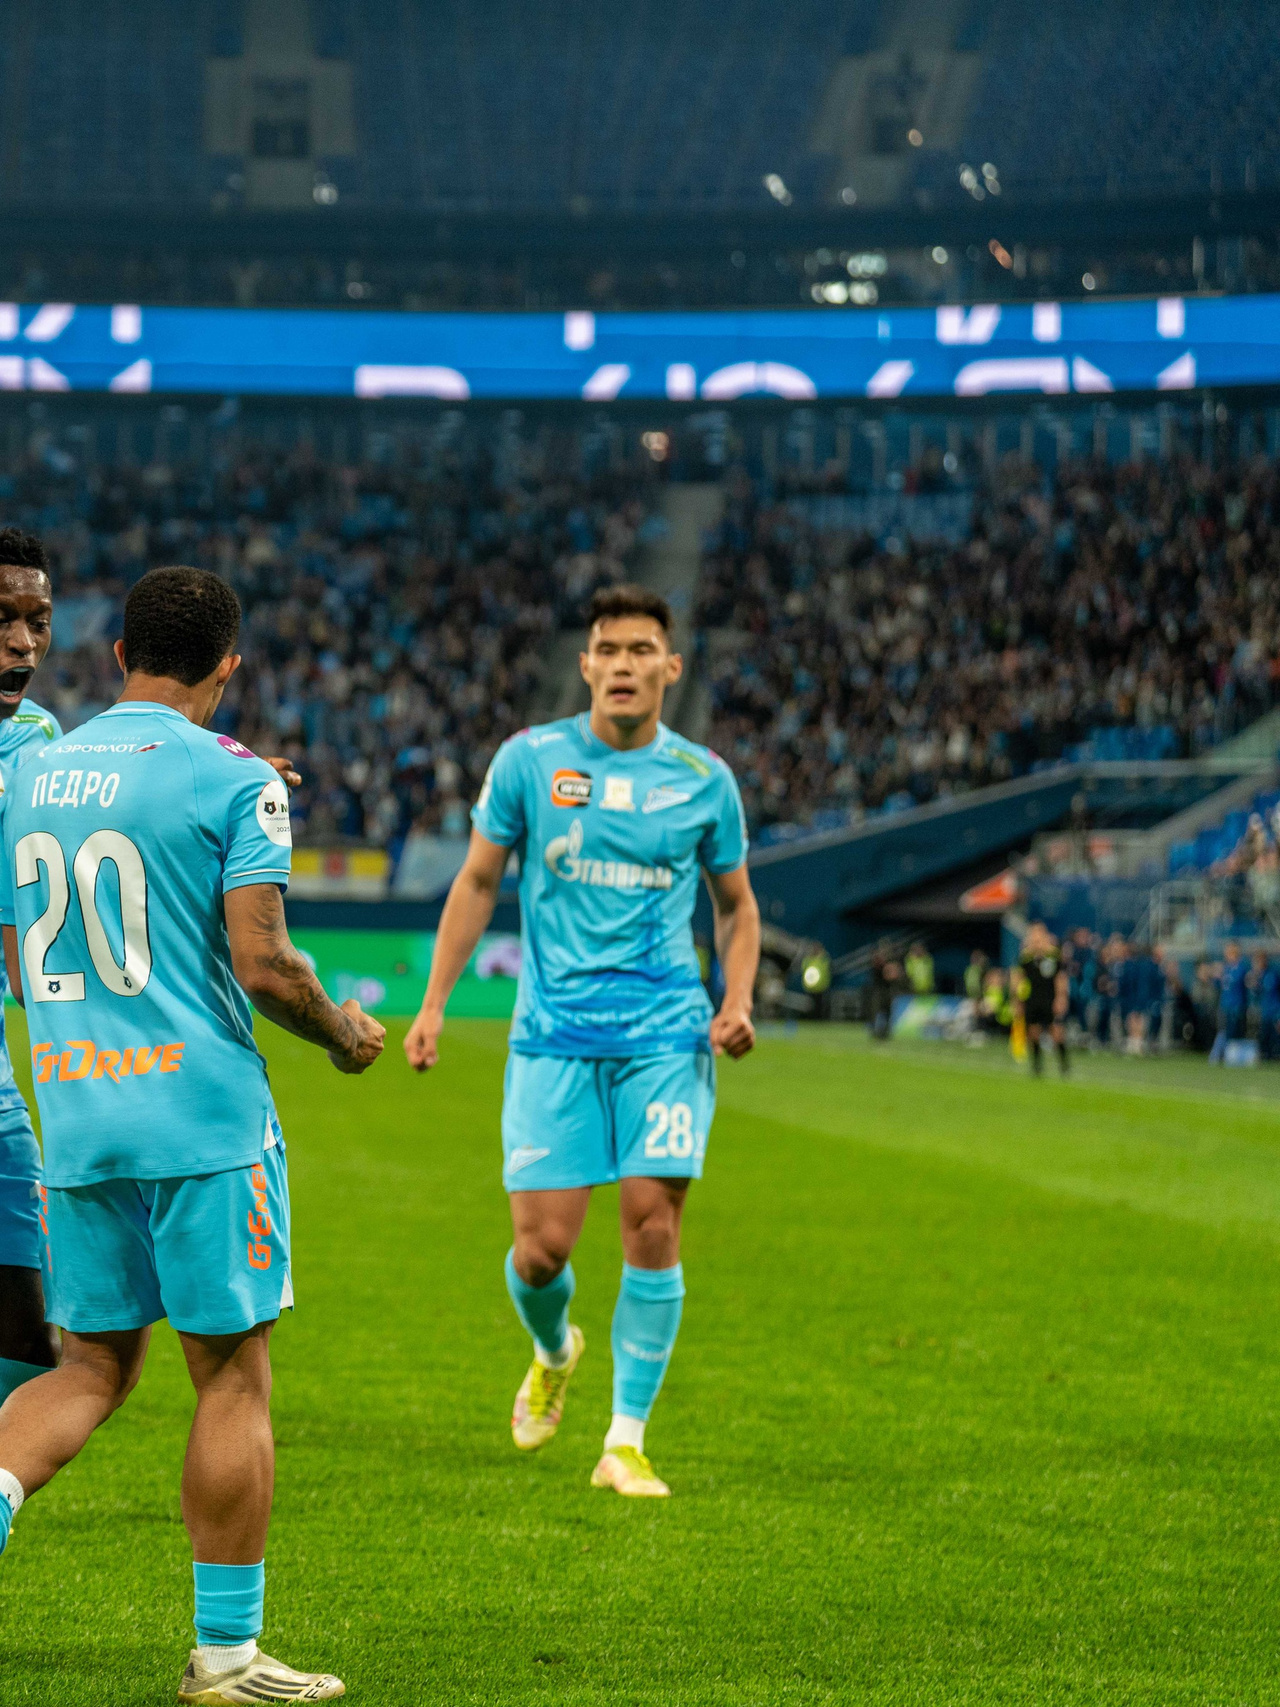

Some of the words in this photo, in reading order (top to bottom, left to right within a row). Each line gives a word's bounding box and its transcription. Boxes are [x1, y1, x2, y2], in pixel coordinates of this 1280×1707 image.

[54, 743, 137, 753] АЭРОФЛОТ
[31, 769, 121, 808] ПЕДРО
[16, 829, 153, 1003] 20
[644, 1101, 694, 1159] 28
